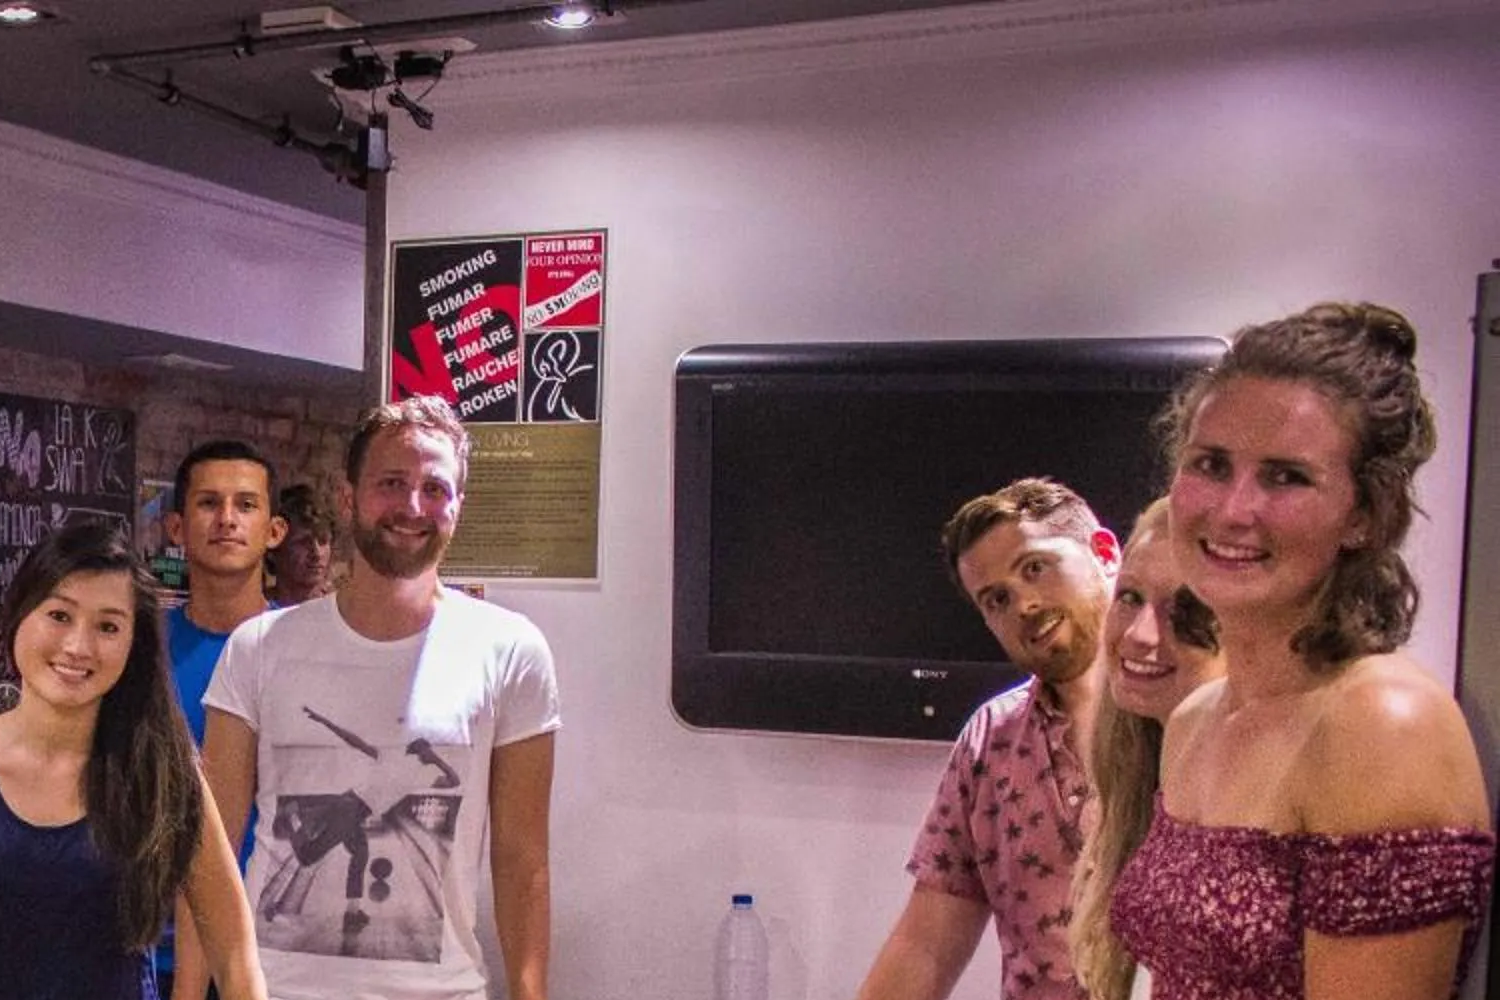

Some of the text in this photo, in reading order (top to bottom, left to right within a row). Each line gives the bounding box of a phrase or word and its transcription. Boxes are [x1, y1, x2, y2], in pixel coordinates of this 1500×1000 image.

[531, 238, 594, 253] NEVER MIND
[419, 249, 497, 297] SMOKING
[427, 282, 487, 321] FUMAR
[435, 307, 494, 345] FUMER
[443, 325, 513, 368] FUMARE
[460, 379, 517, 417] ROKEN
